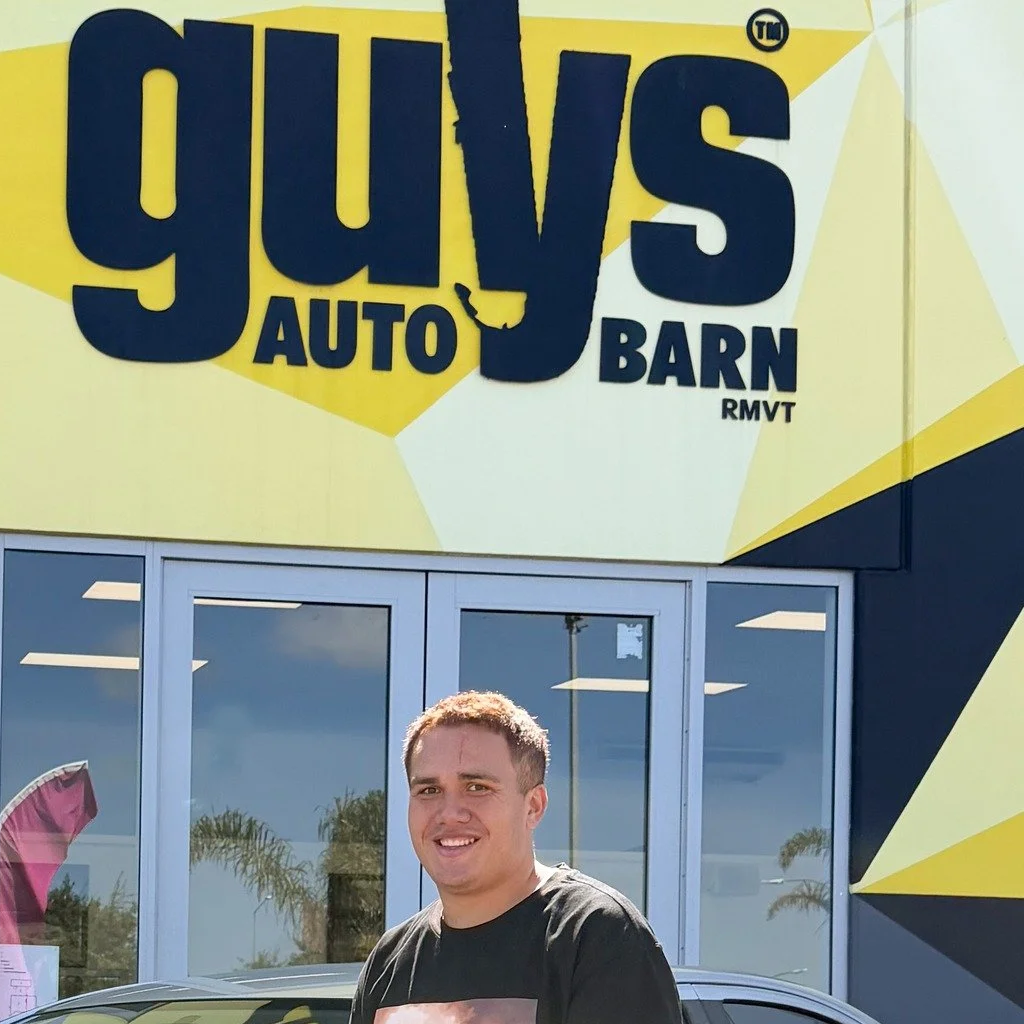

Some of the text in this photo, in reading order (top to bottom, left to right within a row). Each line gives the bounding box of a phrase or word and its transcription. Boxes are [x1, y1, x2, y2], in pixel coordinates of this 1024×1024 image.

[66, 0, 797, 383] guys
[252, 295, 798, 393] AUTO BARN
[721, 398, 796, 424] RMVT
